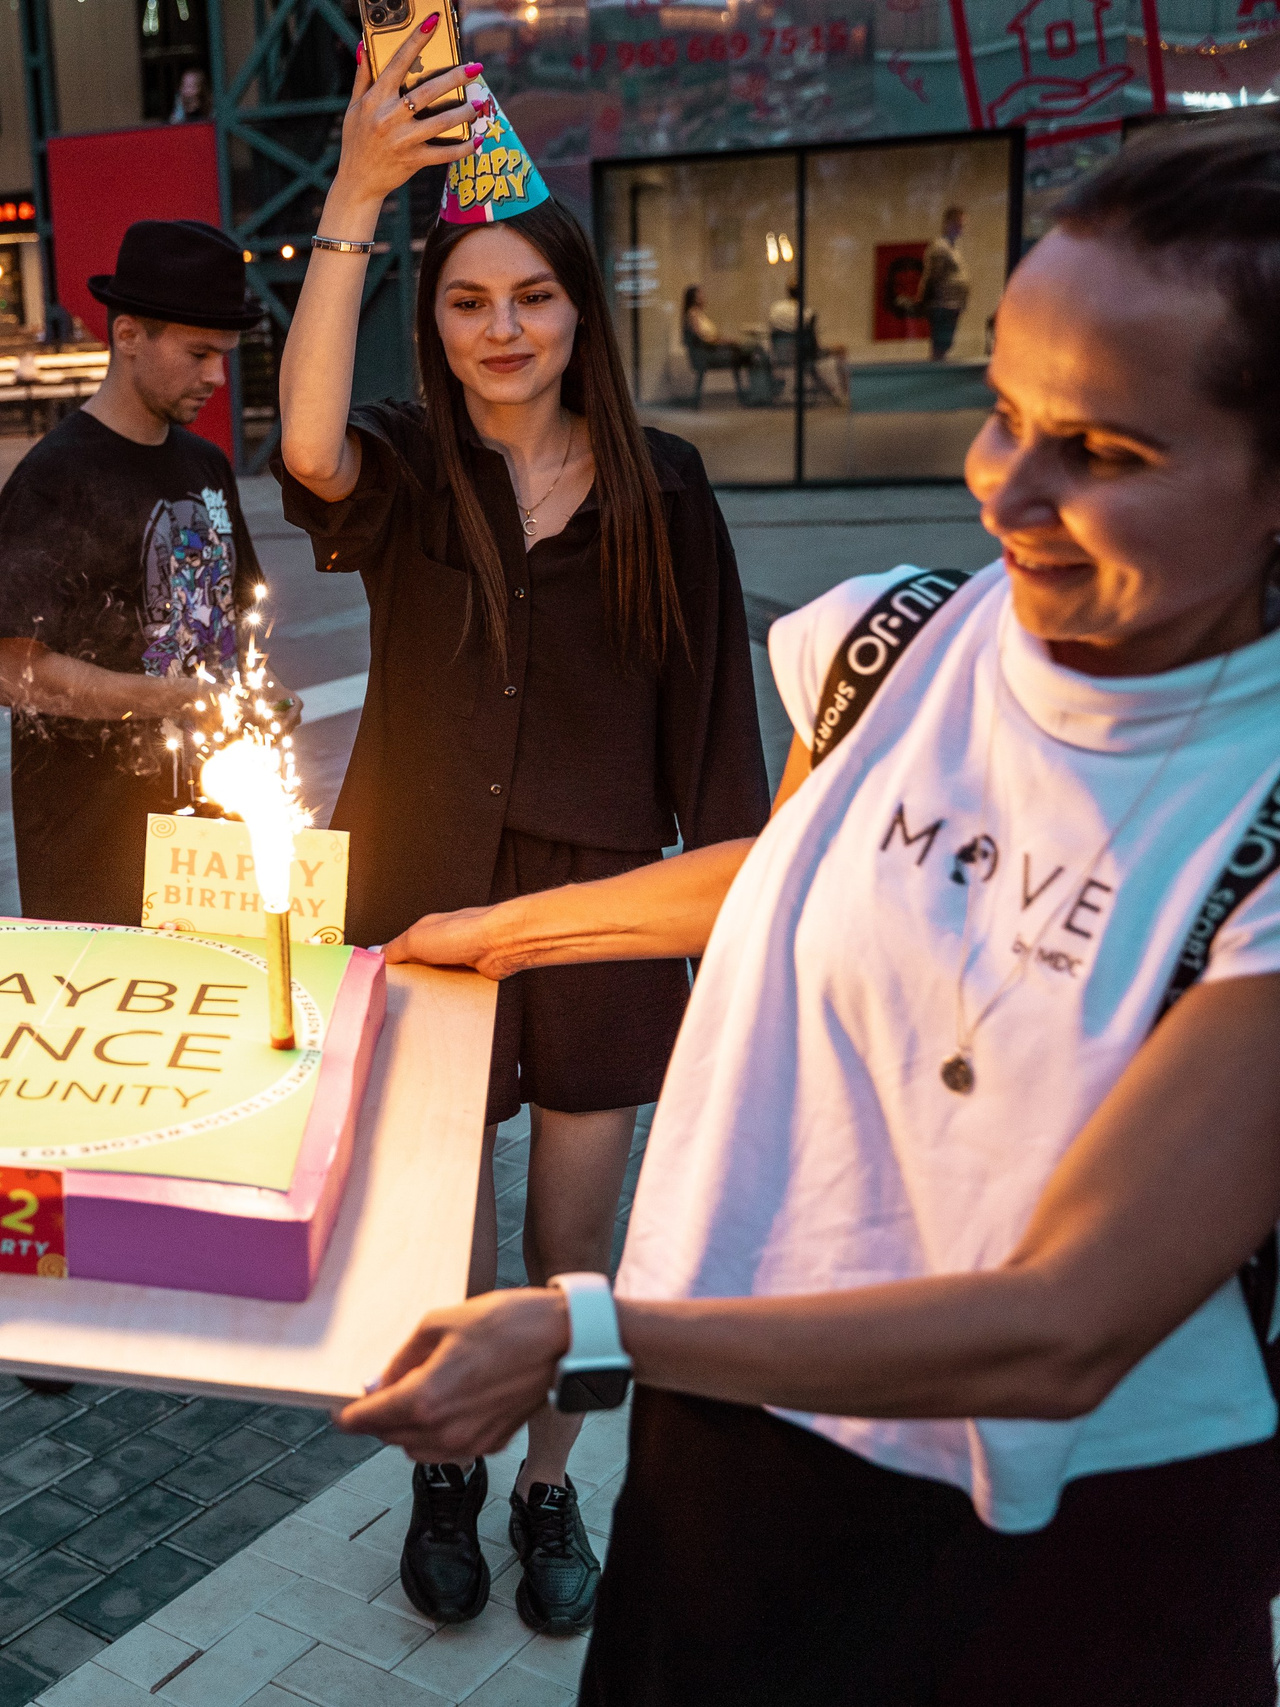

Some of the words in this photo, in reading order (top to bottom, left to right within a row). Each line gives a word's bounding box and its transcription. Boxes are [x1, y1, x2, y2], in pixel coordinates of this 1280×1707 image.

[458, 173, 524, 207] BDAY
[814, 680, 856, 753] SPORT
[170, 847, 324, 888] HAPY
[164, 884, 326, 919] BIRTHAY
[25, 924, 115, 933] WELCOME
[125, 926, 145, 934] TO
[166, 932, 227, 950] SEASON
[0, 1187, 40, 1236] 2
